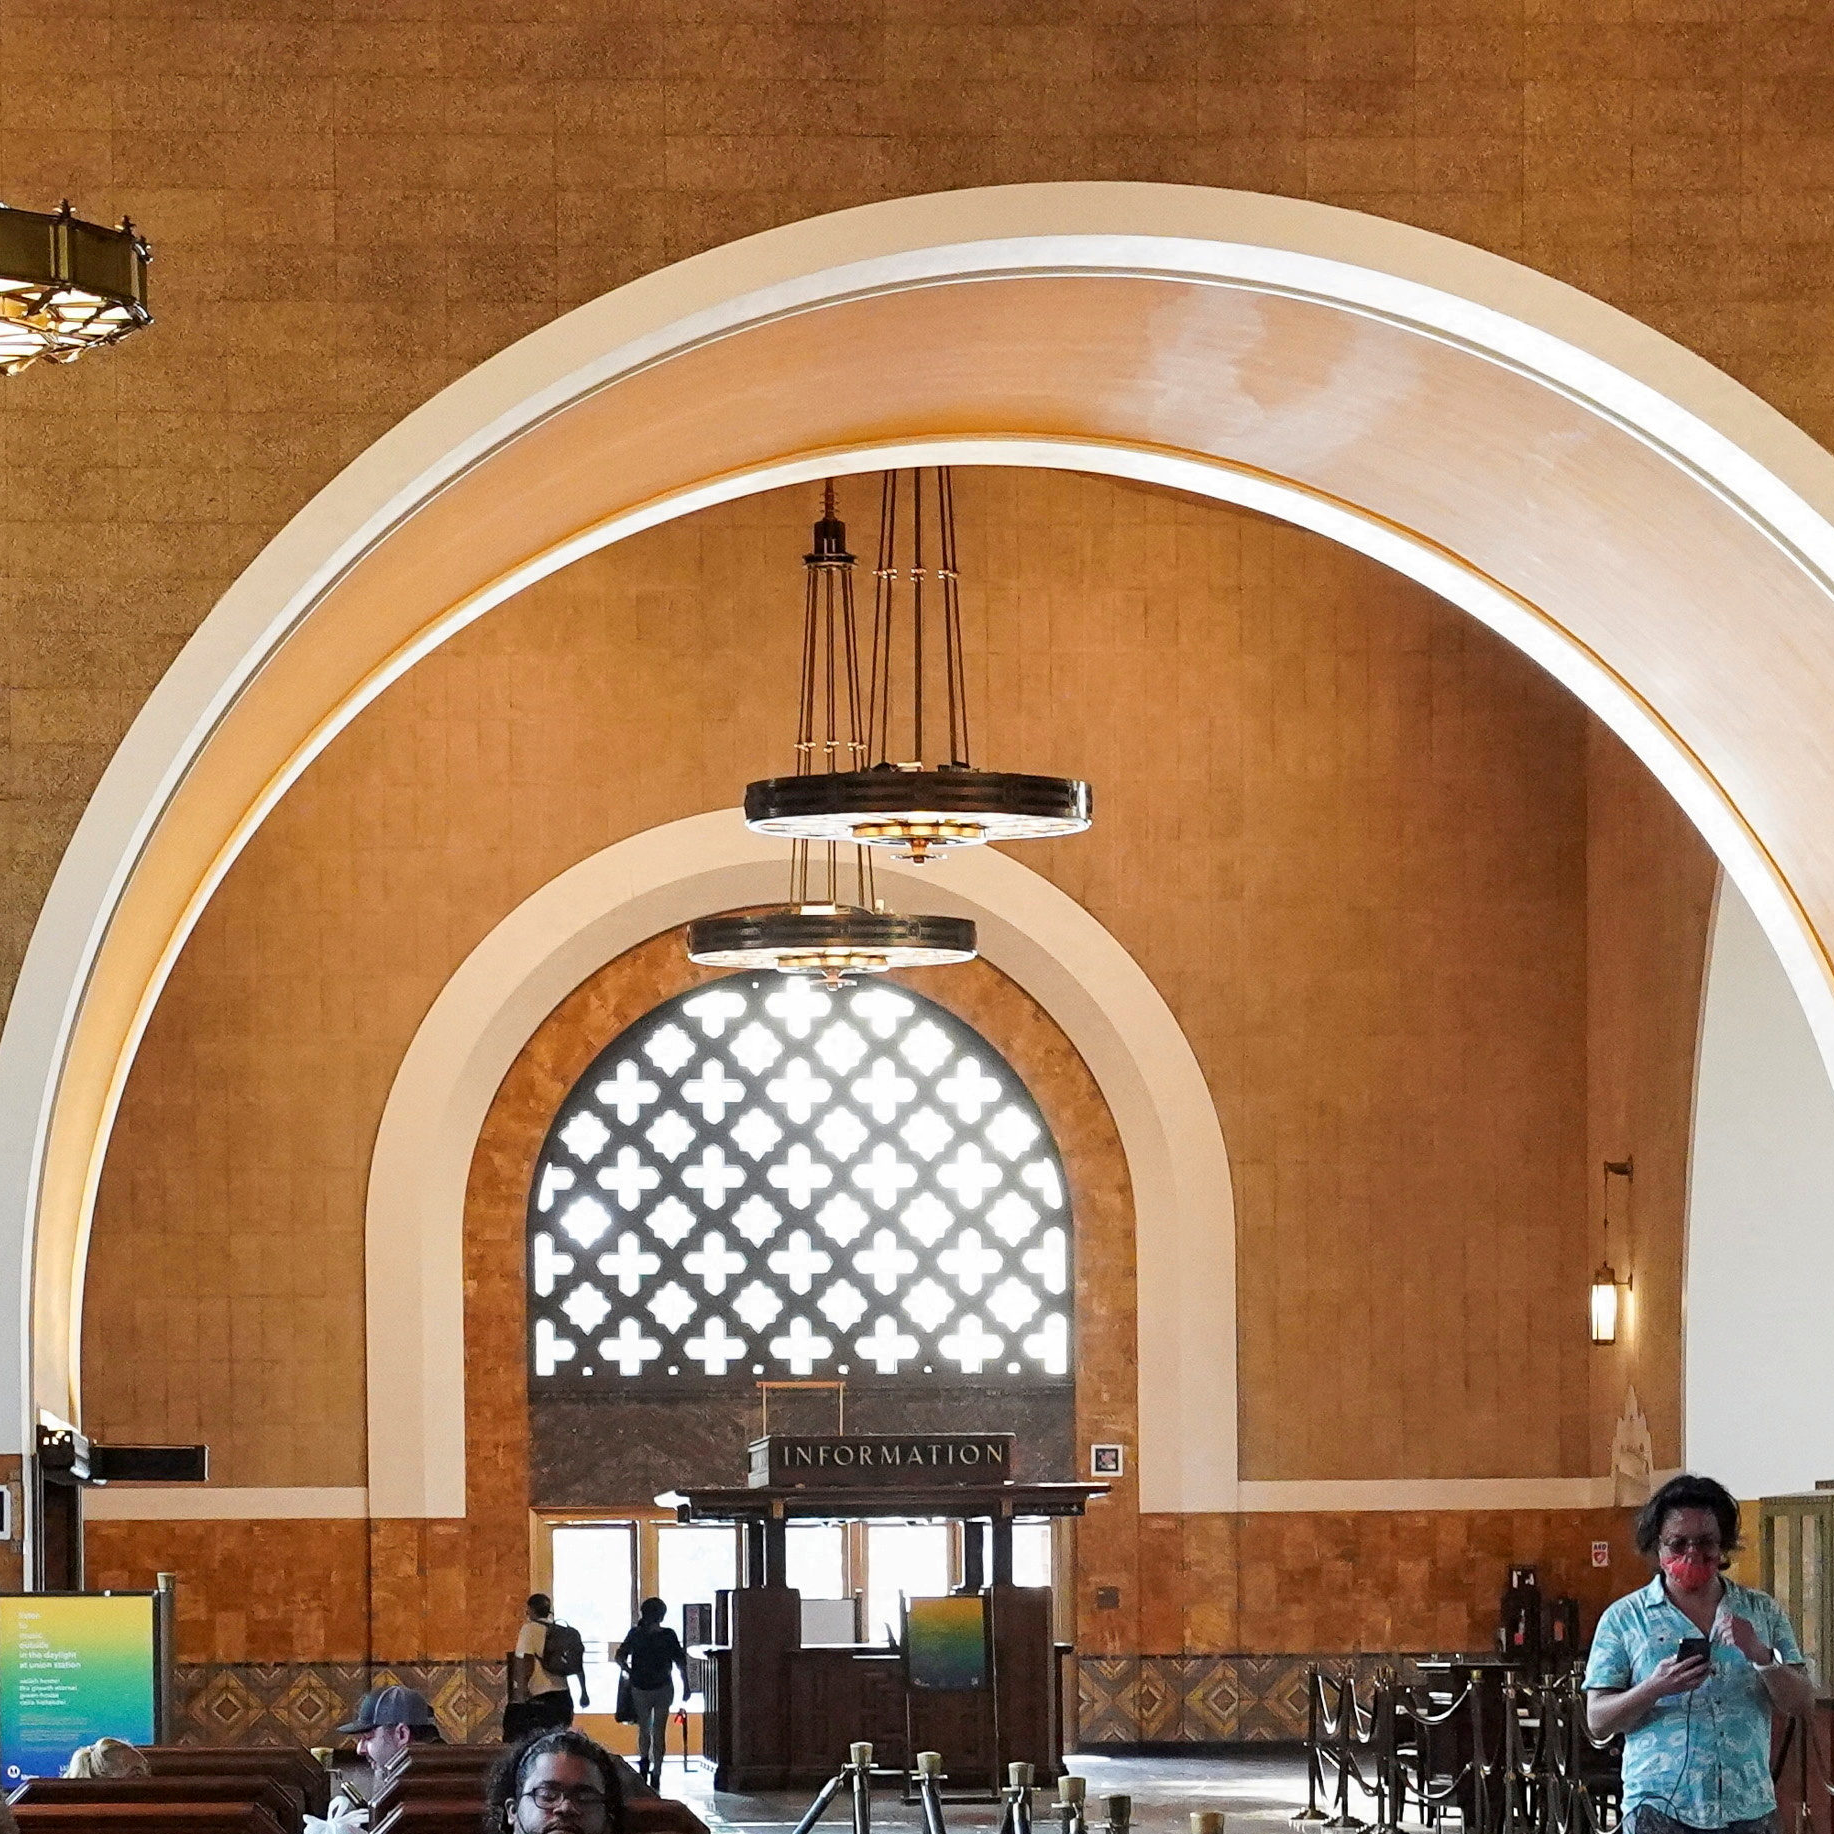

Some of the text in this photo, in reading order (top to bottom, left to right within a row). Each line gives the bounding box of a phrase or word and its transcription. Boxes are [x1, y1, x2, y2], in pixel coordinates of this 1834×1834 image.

[783, 1444, 1003, 1467] INFORMATION
[28, 1651, 42, 1659] the
[44, 1651, 77, 1660] daylight
